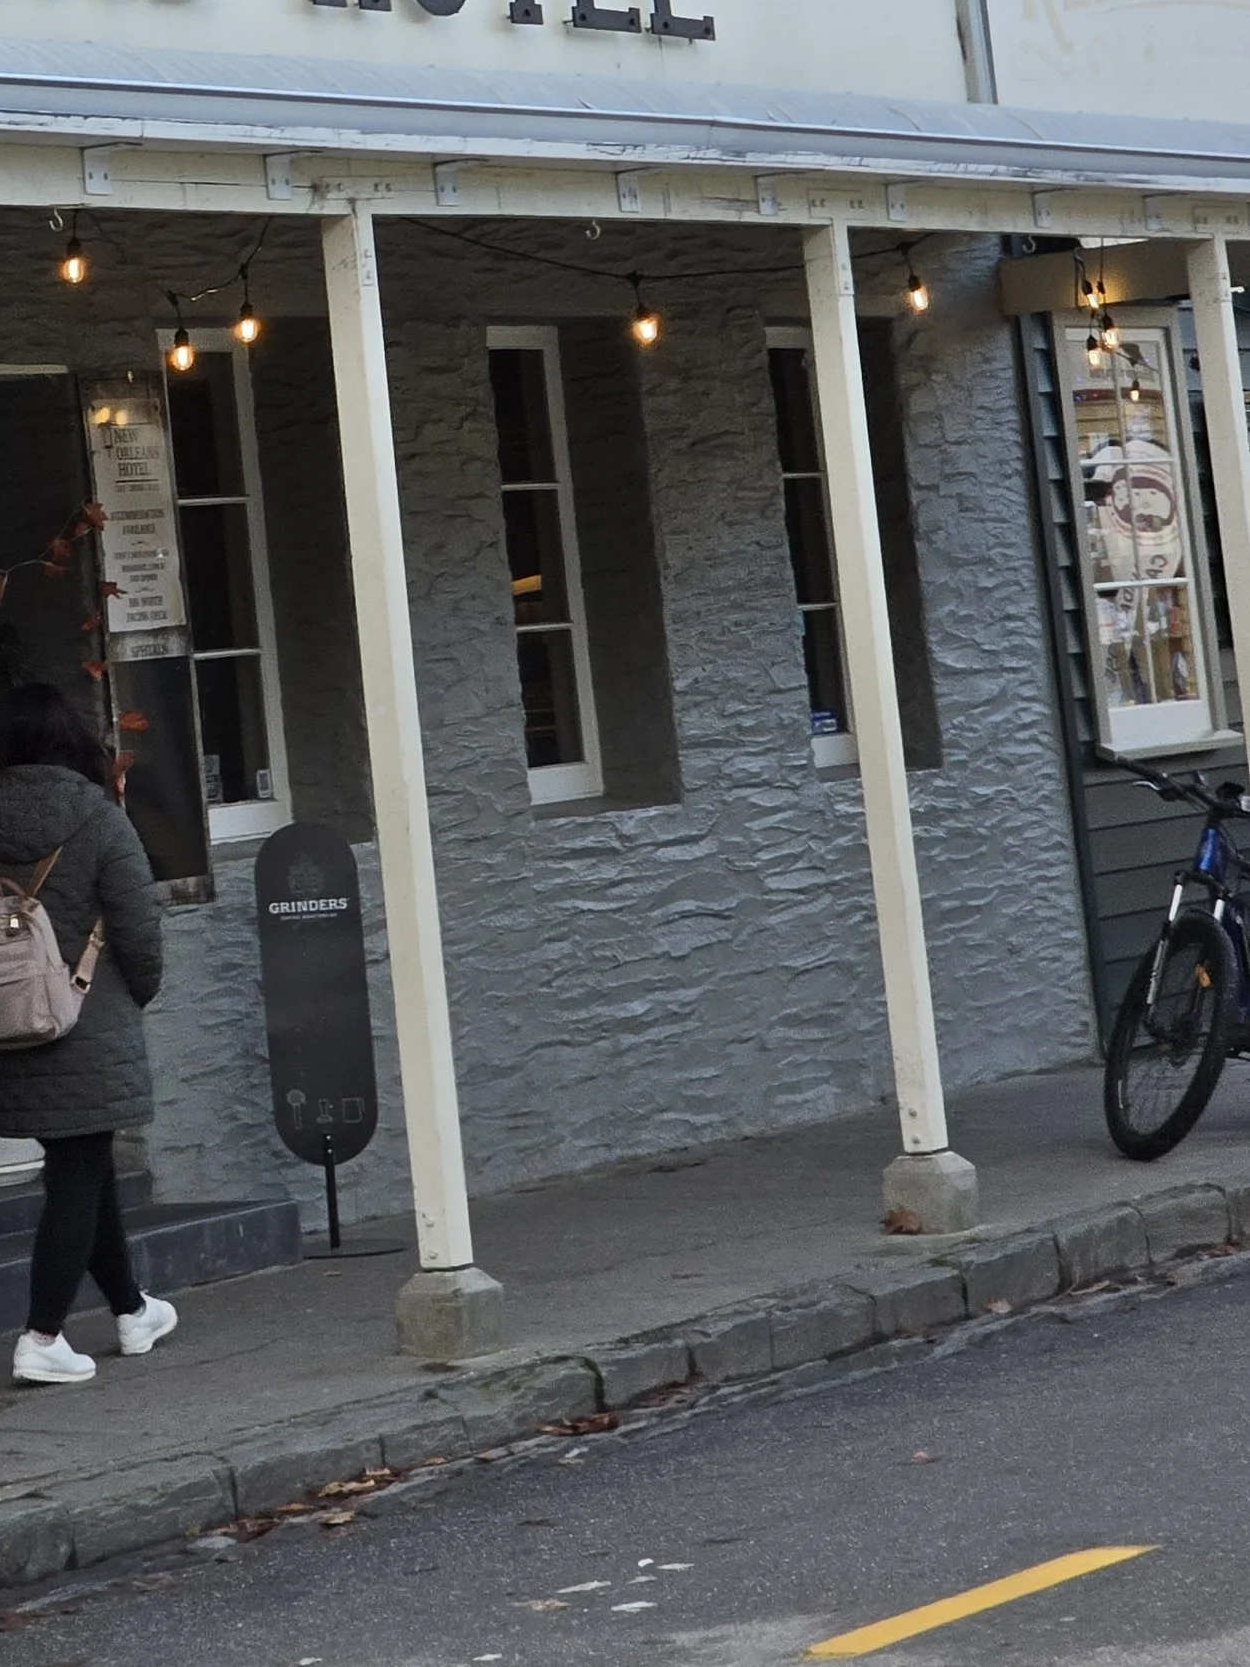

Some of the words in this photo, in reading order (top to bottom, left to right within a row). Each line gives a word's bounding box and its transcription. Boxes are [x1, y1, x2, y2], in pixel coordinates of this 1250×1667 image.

[114, 428, 139, 444] NEW
[117, 462, 151, 476] HOTEL
[268, 898, 348, 914] GRINDERS
